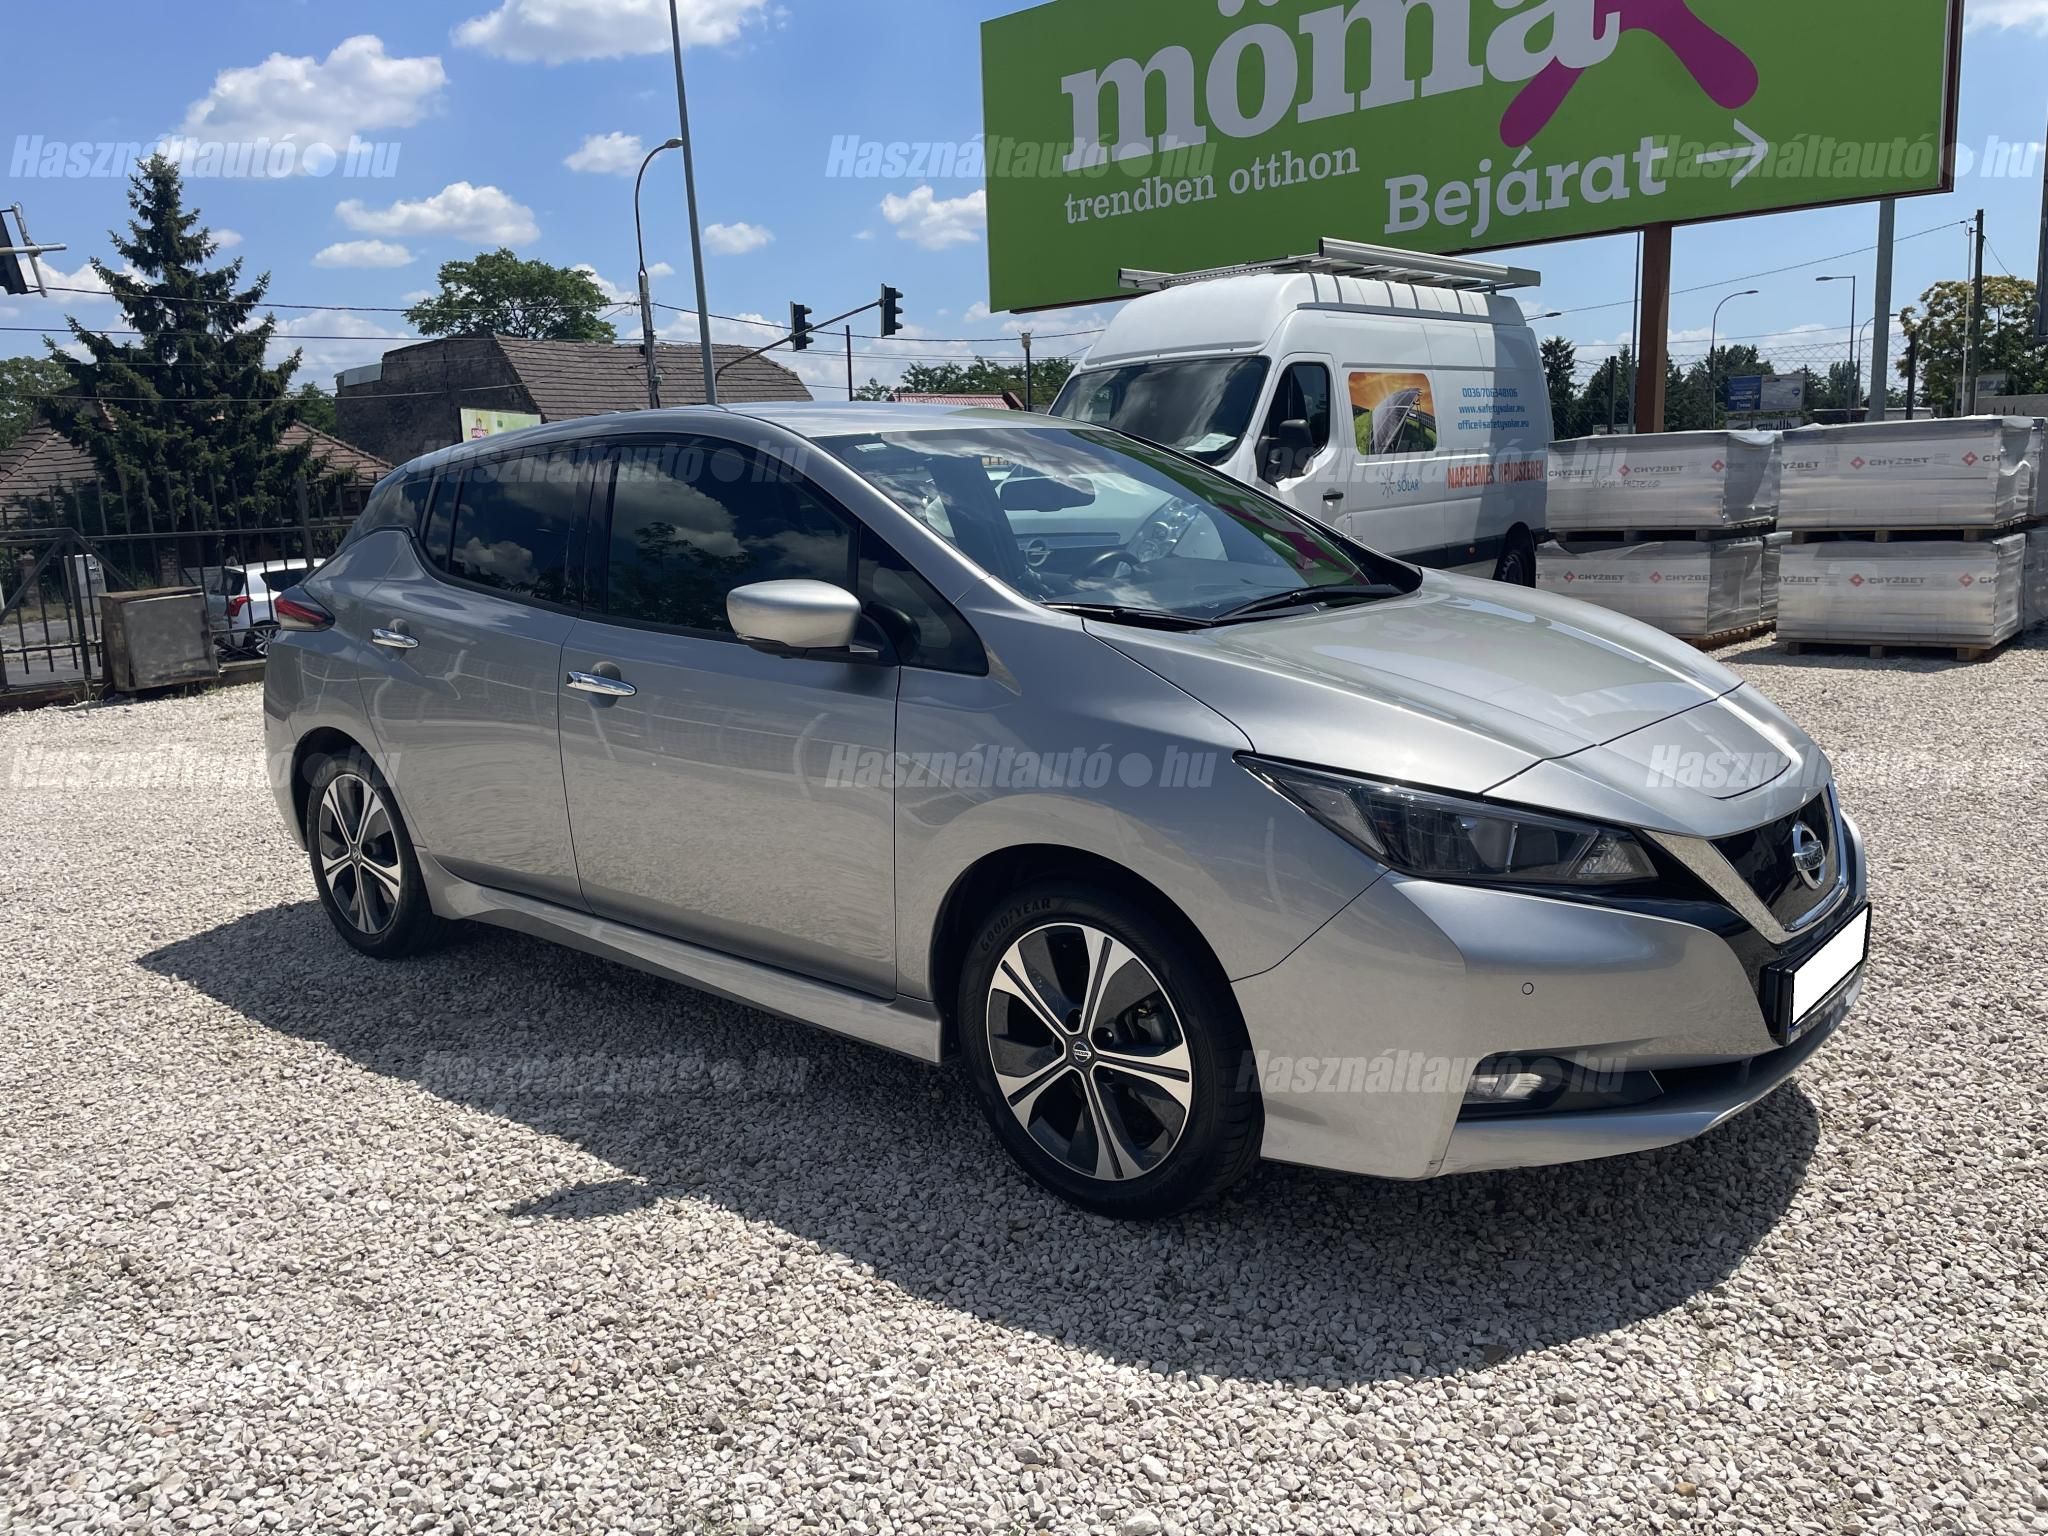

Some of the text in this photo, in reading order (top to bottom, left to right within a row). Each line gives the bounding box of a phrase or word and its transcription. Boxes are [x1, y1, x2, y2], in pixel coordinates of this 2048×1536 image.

[1065, 146, 1360, 224] trendben otthon
[1384, 136, 1668, 238] Bejárat
[1397, 479, 1420, 492] SOLAR
[1448, 464, 1495, 489] NAPELEMES
[979, 897, 1052, 952] GOODYEAR
